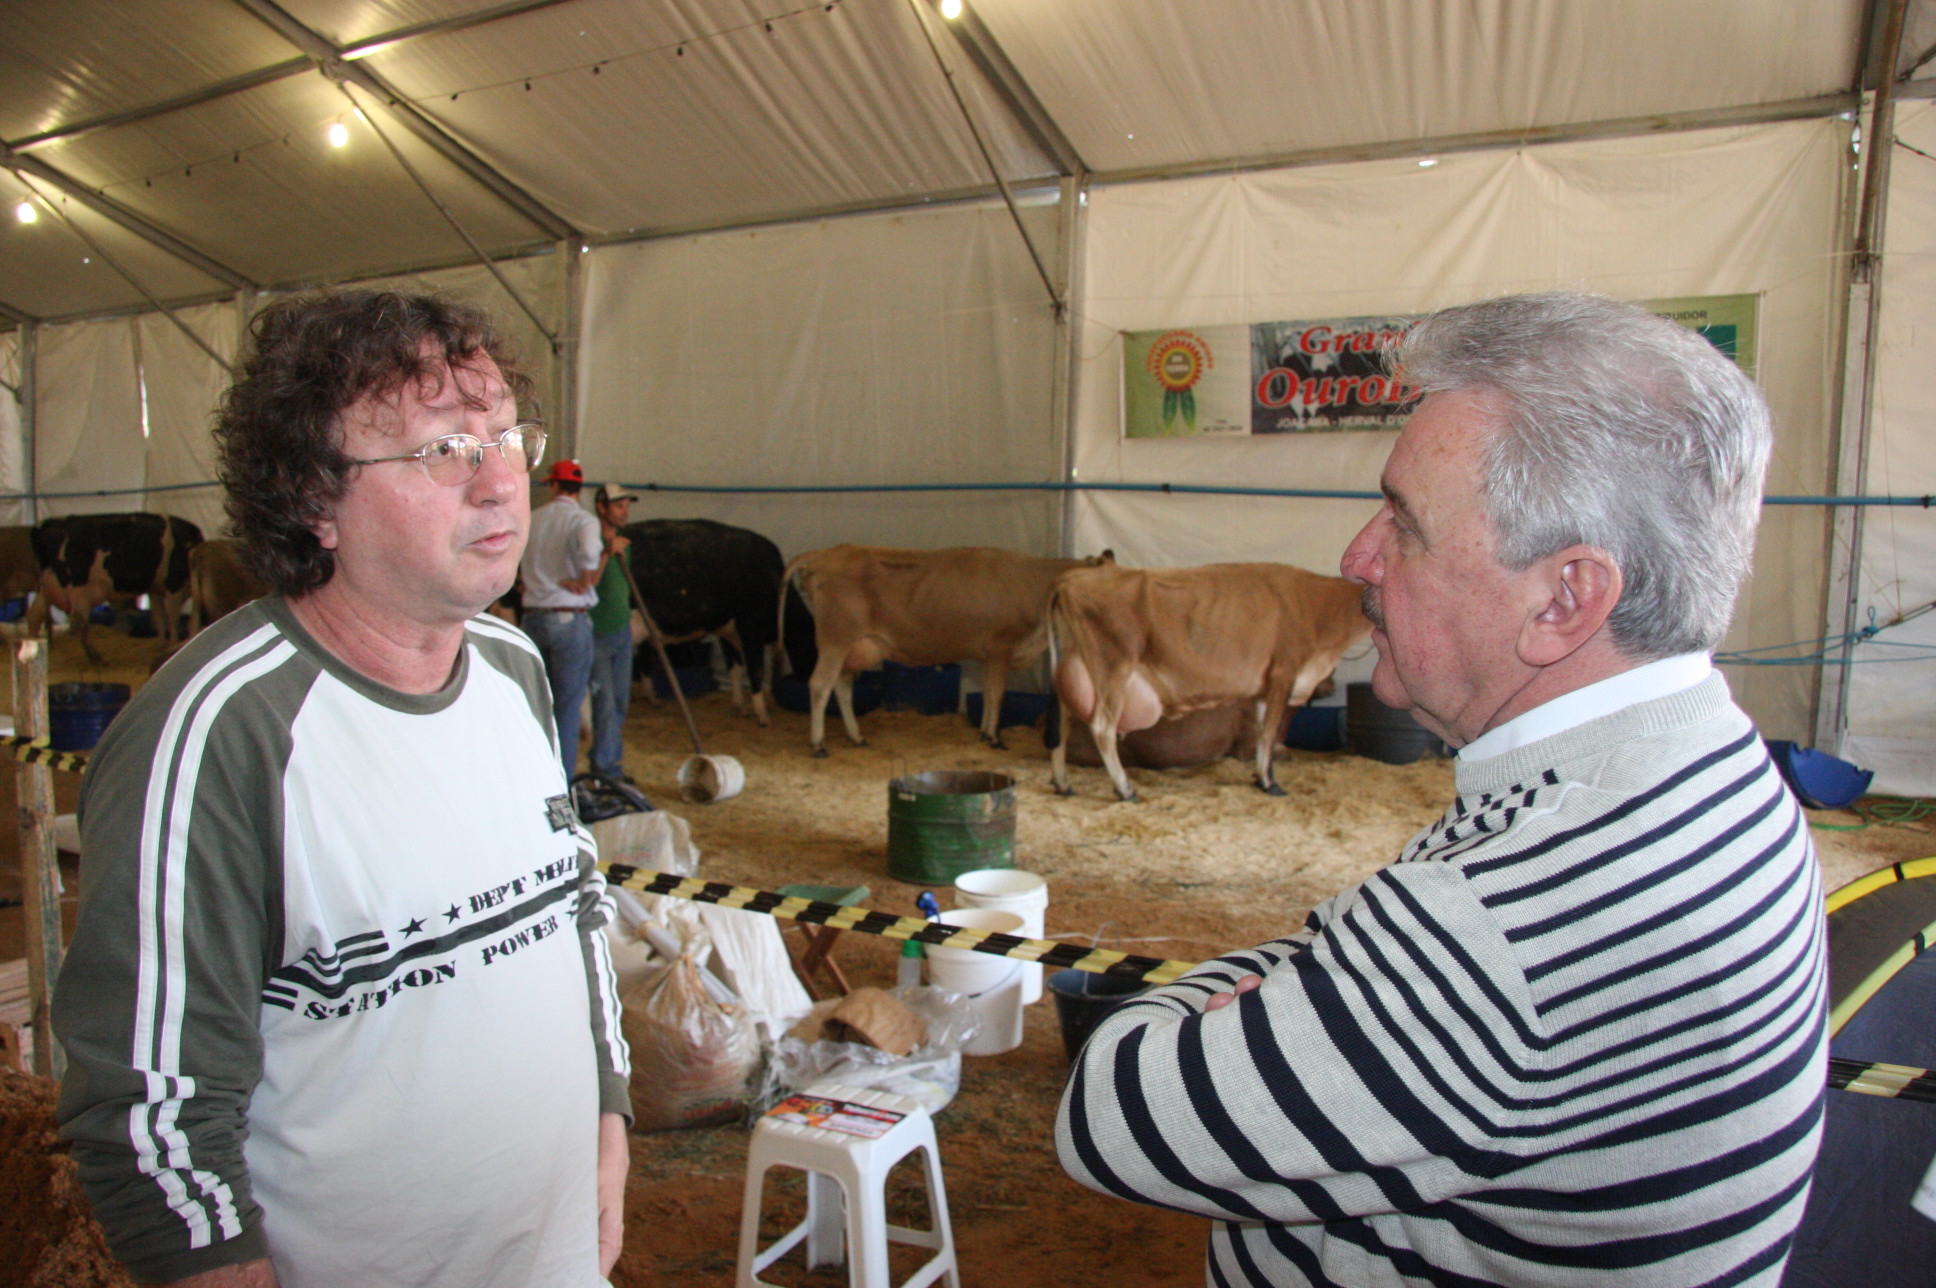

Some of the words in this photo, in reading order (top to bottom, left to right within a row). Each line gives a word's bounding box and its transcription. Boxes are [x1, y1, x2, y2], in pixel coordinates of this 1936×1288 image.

[1299, 320, 1421, 355] Gran
[467, 875, 527, 914] DEPT
[303, 959, 457, 1021] STATION
[480, 914, 559, 966] POWER
